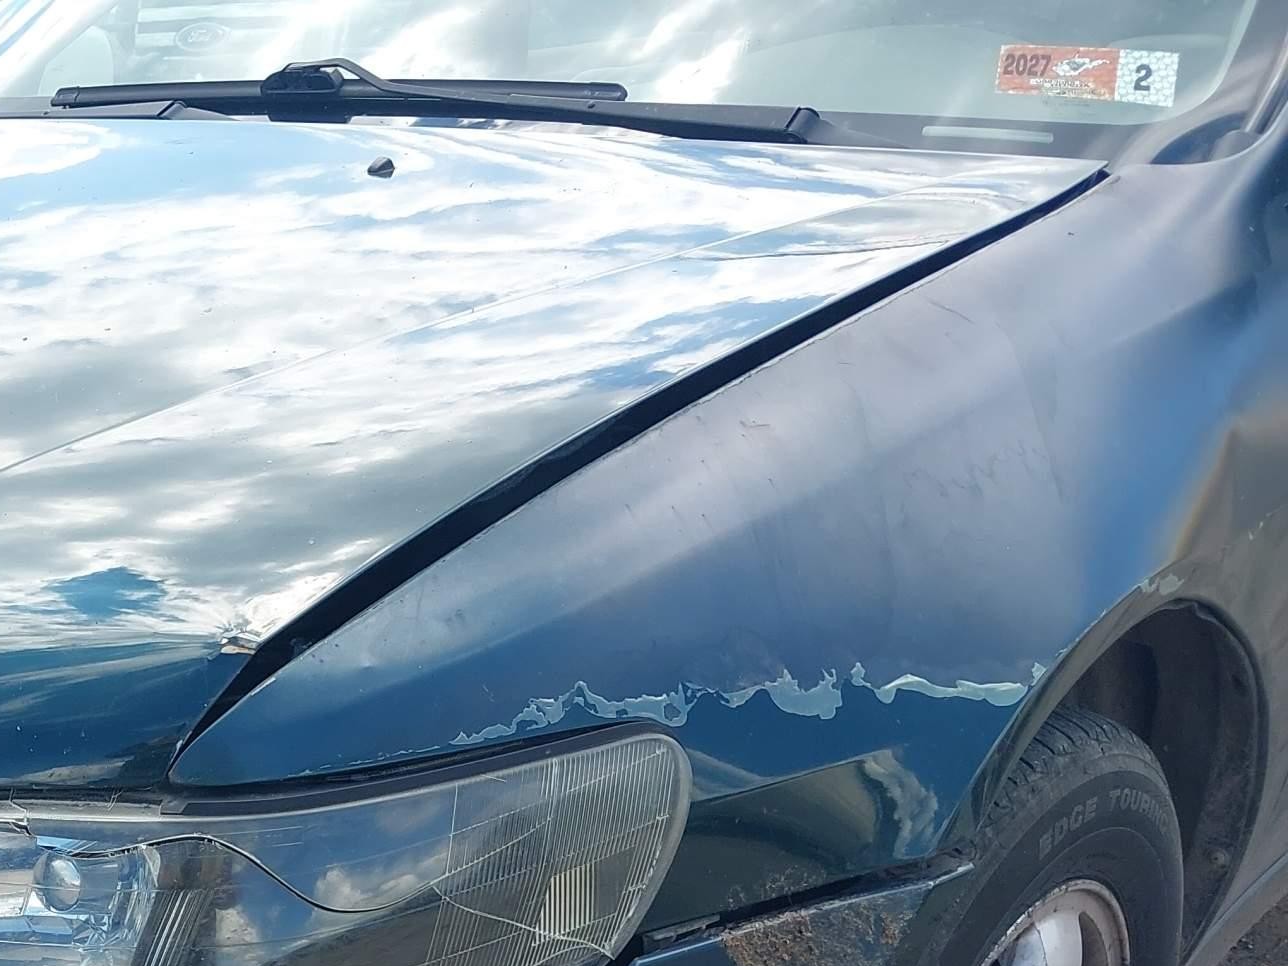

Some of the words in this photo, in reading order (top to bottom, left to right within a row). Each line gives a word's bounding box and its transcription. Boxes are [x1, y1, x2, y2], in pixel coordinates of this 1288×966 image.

[1003, 53, 1051, 77] 2027
[1133, 64, 1153, 92] 2
[1039, 796, 1098, 861] EDGE
